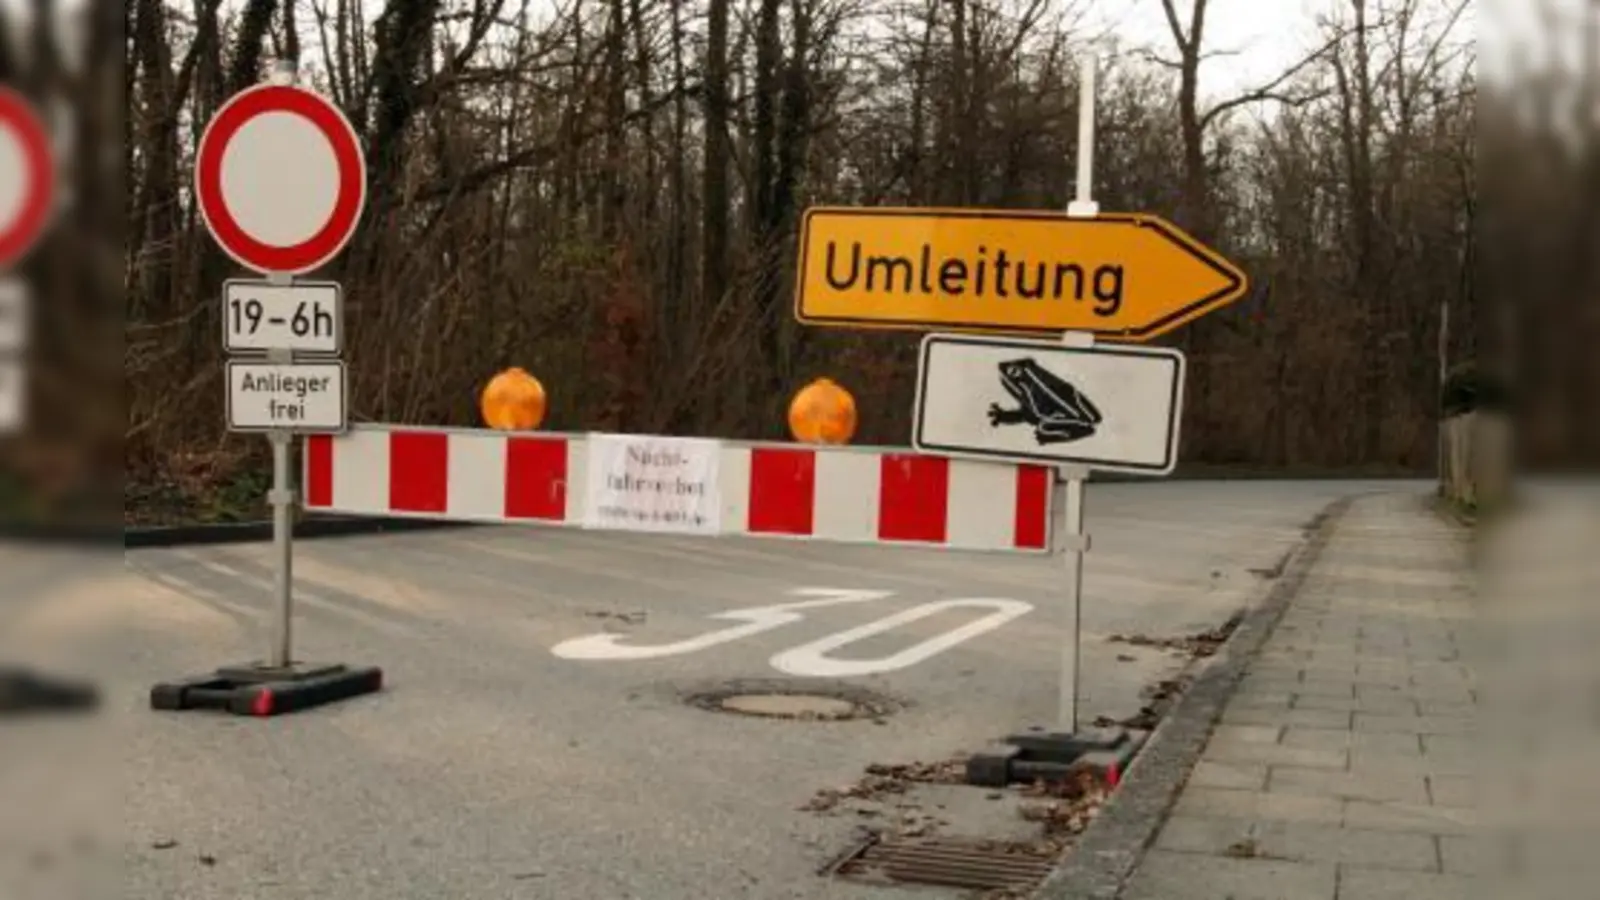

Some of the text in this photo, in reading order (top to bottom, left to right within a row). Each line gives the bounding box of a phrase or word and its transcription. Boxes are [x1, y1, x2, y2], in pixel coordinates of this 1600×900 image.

[825, 241, 1123, 316] Umleitung
[241, 372, 331, 397] Anlieger
[269, 399, 305, 420] frei
[606, 472, 705, 497] fahrebot
[551, 588, 1034, 677] 30
